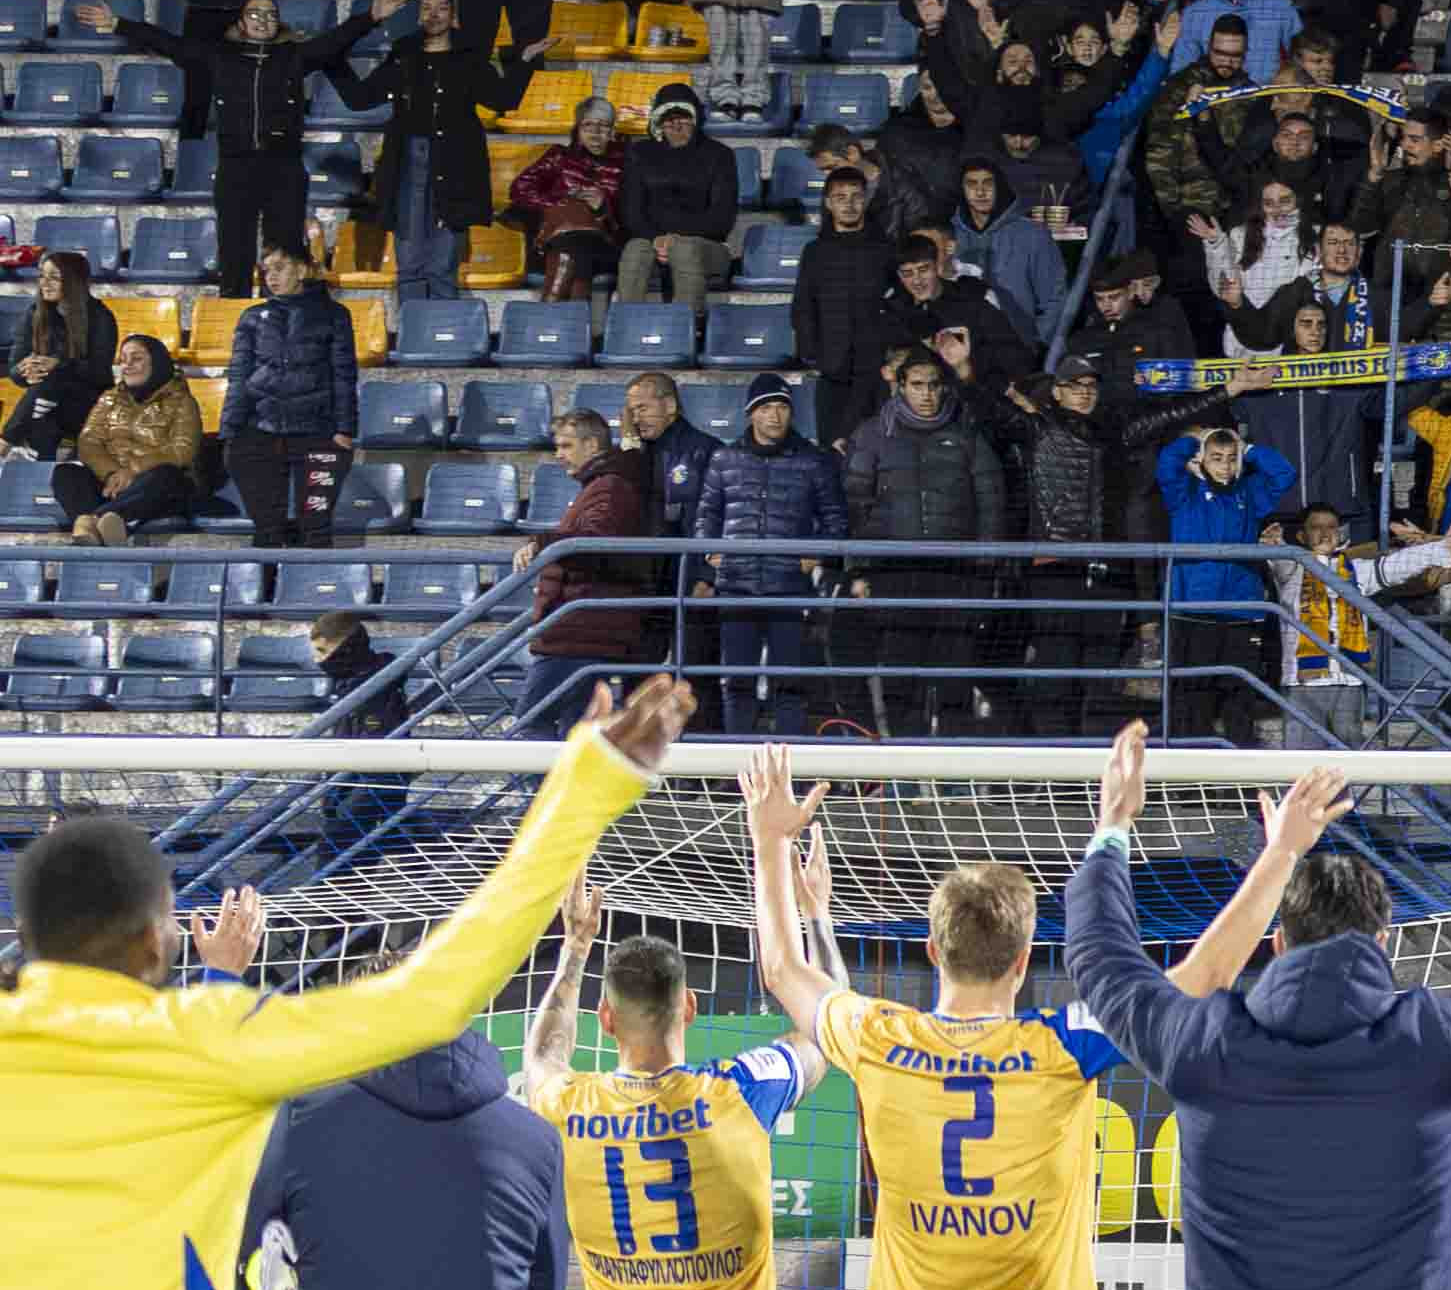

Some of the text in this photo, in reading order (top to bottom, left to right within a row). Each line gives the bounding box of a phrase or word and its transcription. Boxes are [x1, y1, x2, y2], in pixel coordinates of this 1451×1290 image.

[566, 1097, 713, 1141] novibet
[941, 1074, 995, 1198] 2
[603, 1137, 699, 1257] 13
[909, 1198, 1036, 1238] IVANOV
